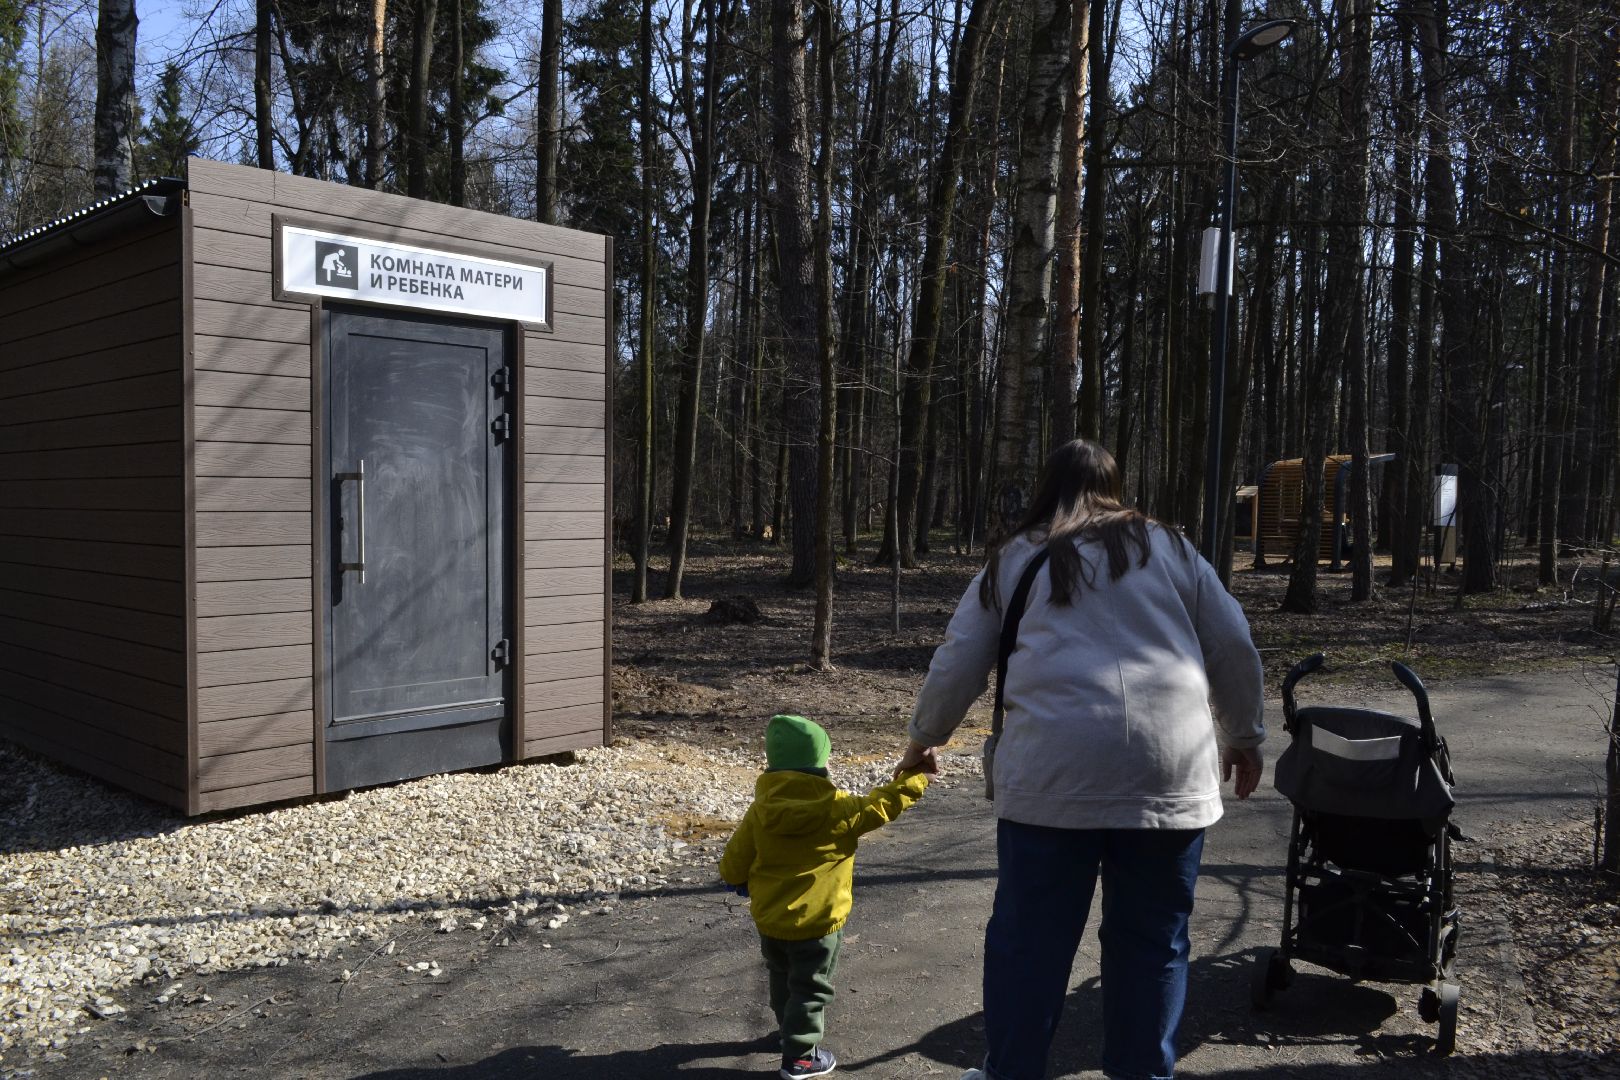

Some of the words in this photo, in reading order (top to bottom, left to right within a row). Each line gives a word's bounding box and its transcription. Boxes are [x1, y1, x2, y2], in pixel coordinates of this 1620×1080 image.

[370, 253, 455, 280] КОМНАТА
[460, 267, 523, 291] МАТЕРИ
[370, 273, 382, 289] И
[388, 275, 464, 300] РЕБЕНКА
